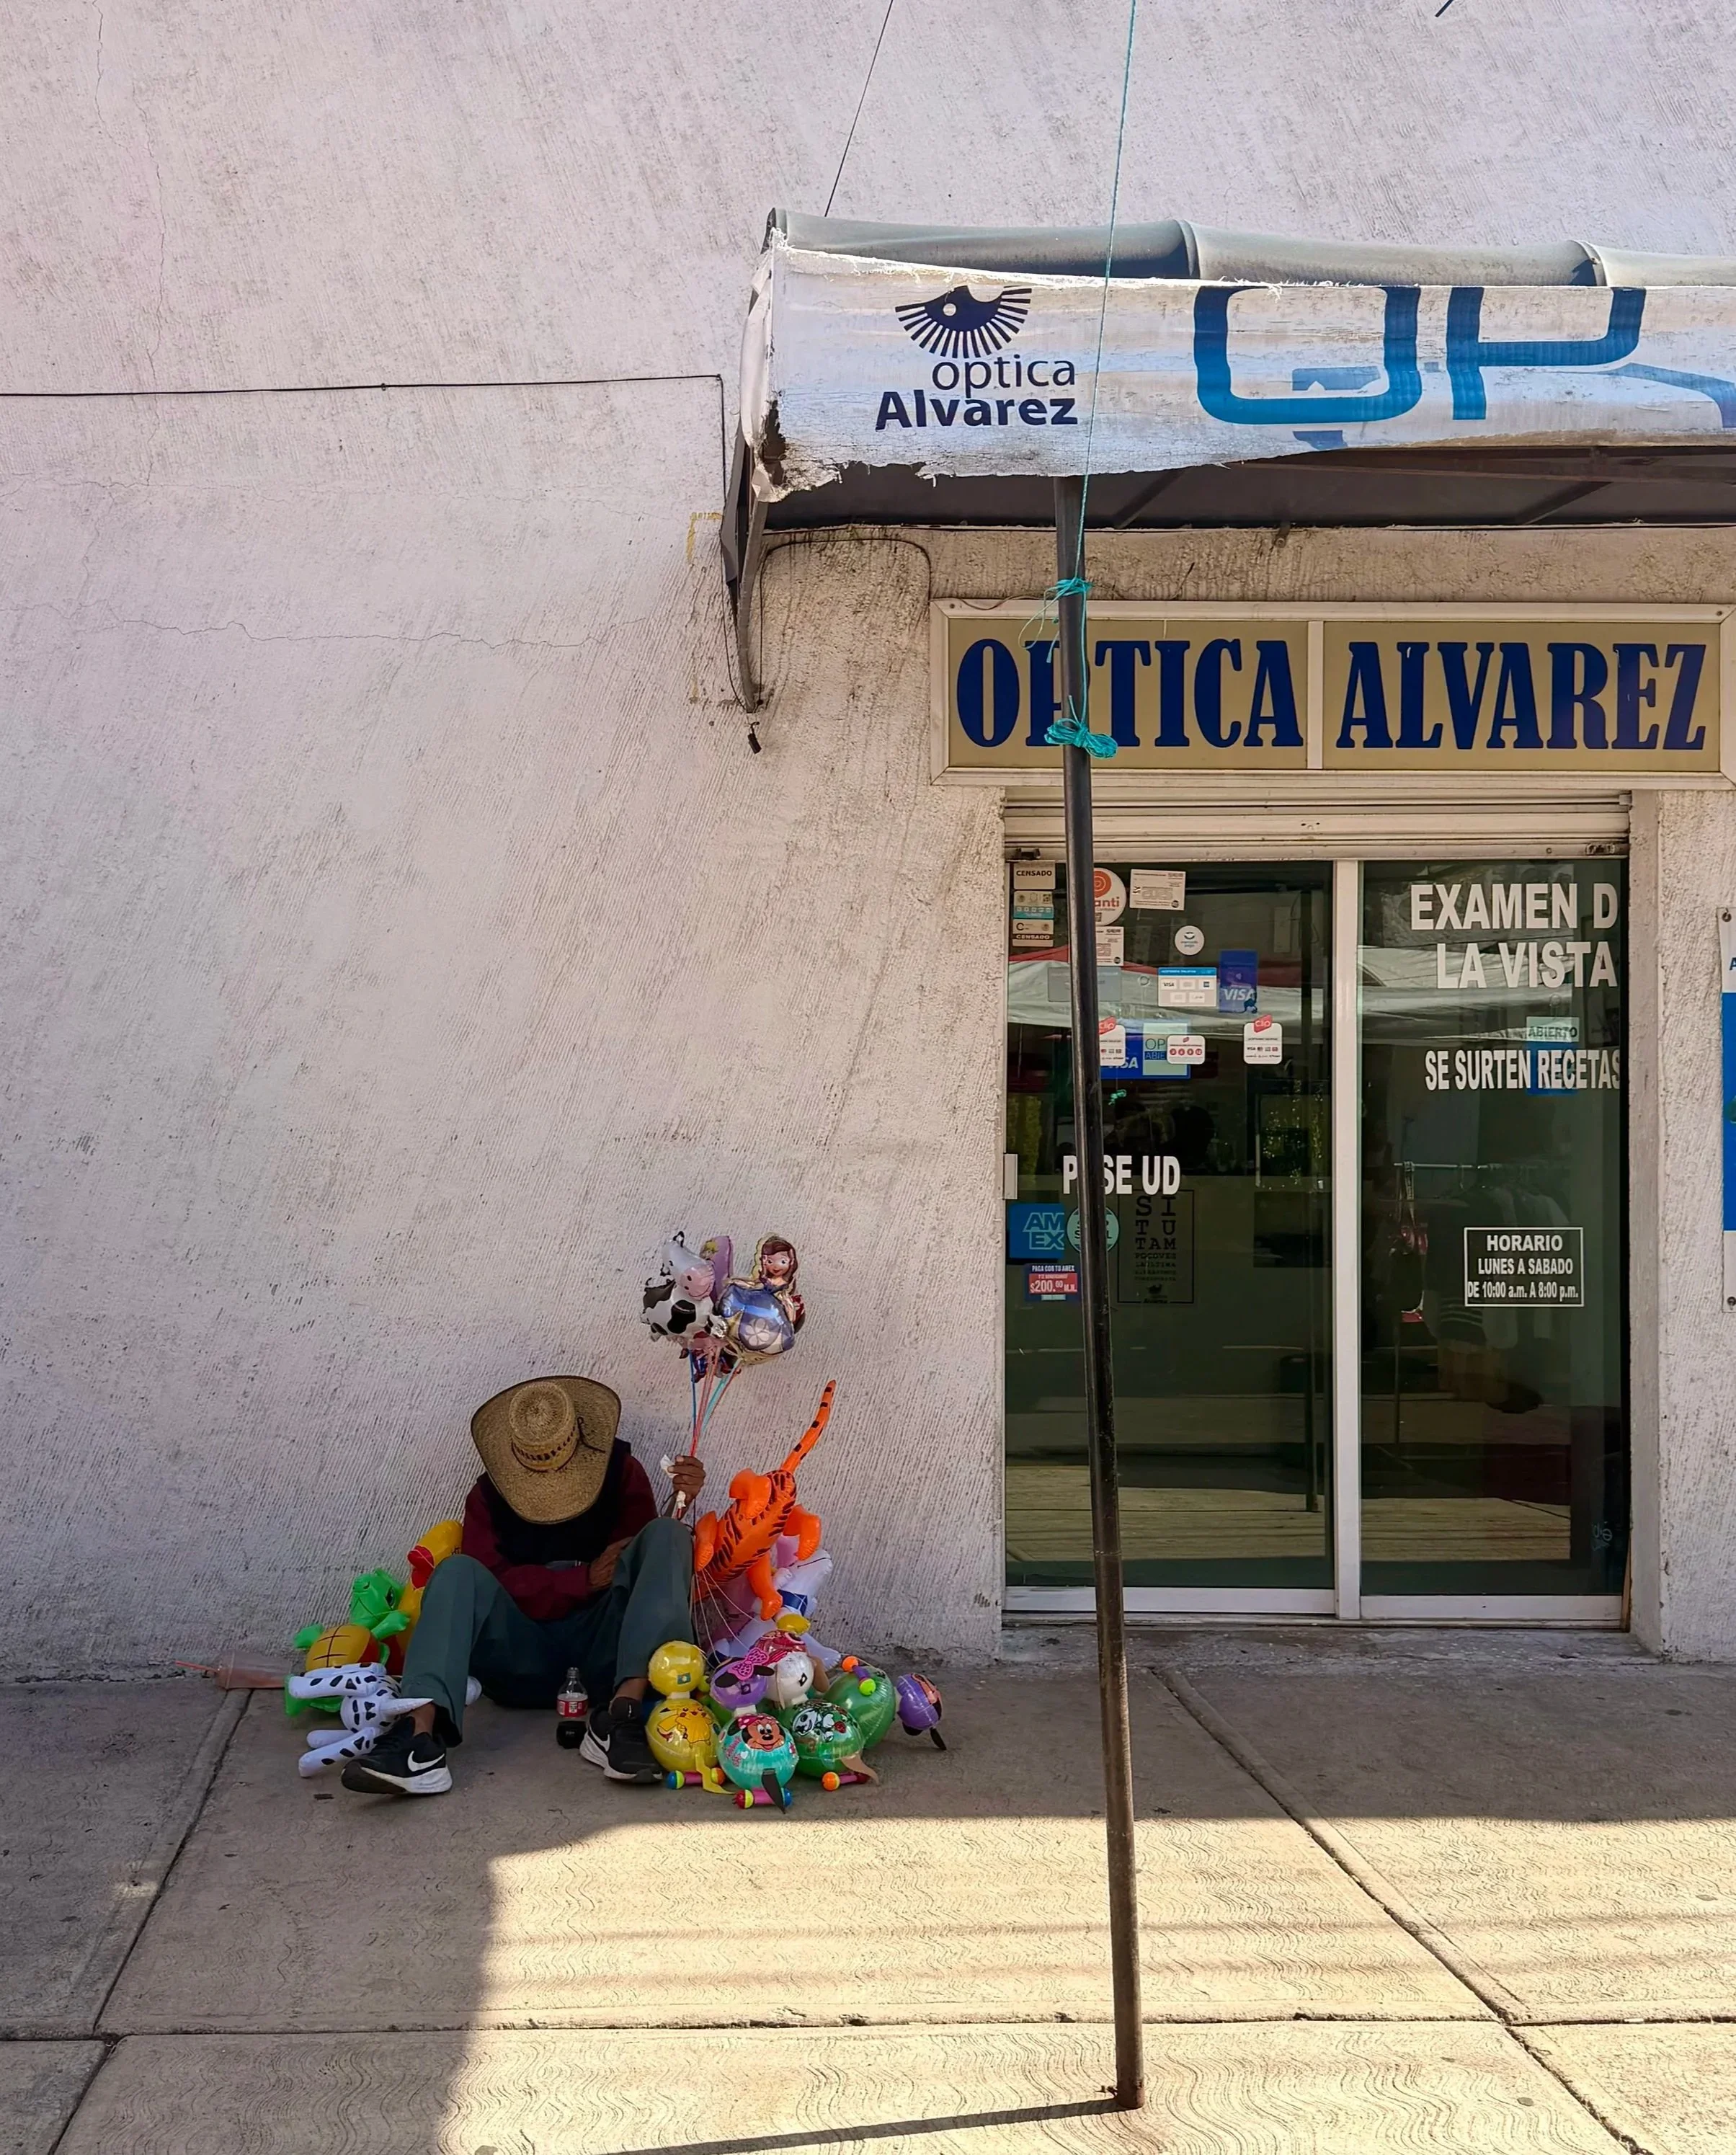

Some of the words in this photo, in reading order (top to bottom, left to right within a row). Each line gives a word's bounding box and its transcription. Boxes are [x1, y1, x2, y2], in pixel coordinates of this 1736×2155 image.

[932, 354, 1075, 398] optica
[876, 389, 1077, 430] Alvarez
[1335, 641, 1707, 750] ALVAREZ
[1094, 896, 1120, 907] anti
[1410, 883, 1577, 930] EXAMEN
[1593, 883, 1619, 930] D
[1436, 942, 1487, 989] LA
[1498, 941, 1618, 988] VISTA
[1223, 988, 1256, 1000] VISA
[1145, 1038, 1165, 1050] OP
[1528, 1026, 1577, 1038] ABIERTO
[1425, 1050, 1450, 1090] SE
[1455, 1049, 1531, 1090] SURTEN
[1537, 1049, 1620, 1089] RECETAS
[1063, 1155, 1133, 1195] PSE
[1142, 1155, 1181, 1195] UD
[1487, 1235, 1563, 1251] HORARIO
[1478, 1258, 1515, 1275] LUNES
[1517, 1258, 1526, 1274] A
[1528, 1258, 1573, 1274] SABADO
[1467, 1281, 1479, 1297] DE
[1482, 1281, 1506, 1298] 10:00
[1508, 1285, 1527, 1297] a.m.
[1529, 1281, 1536, 1297] A
[1538, 1281, 1557, 1297] 8:00
[1559, 1285, 1578, 1302] p.m.
